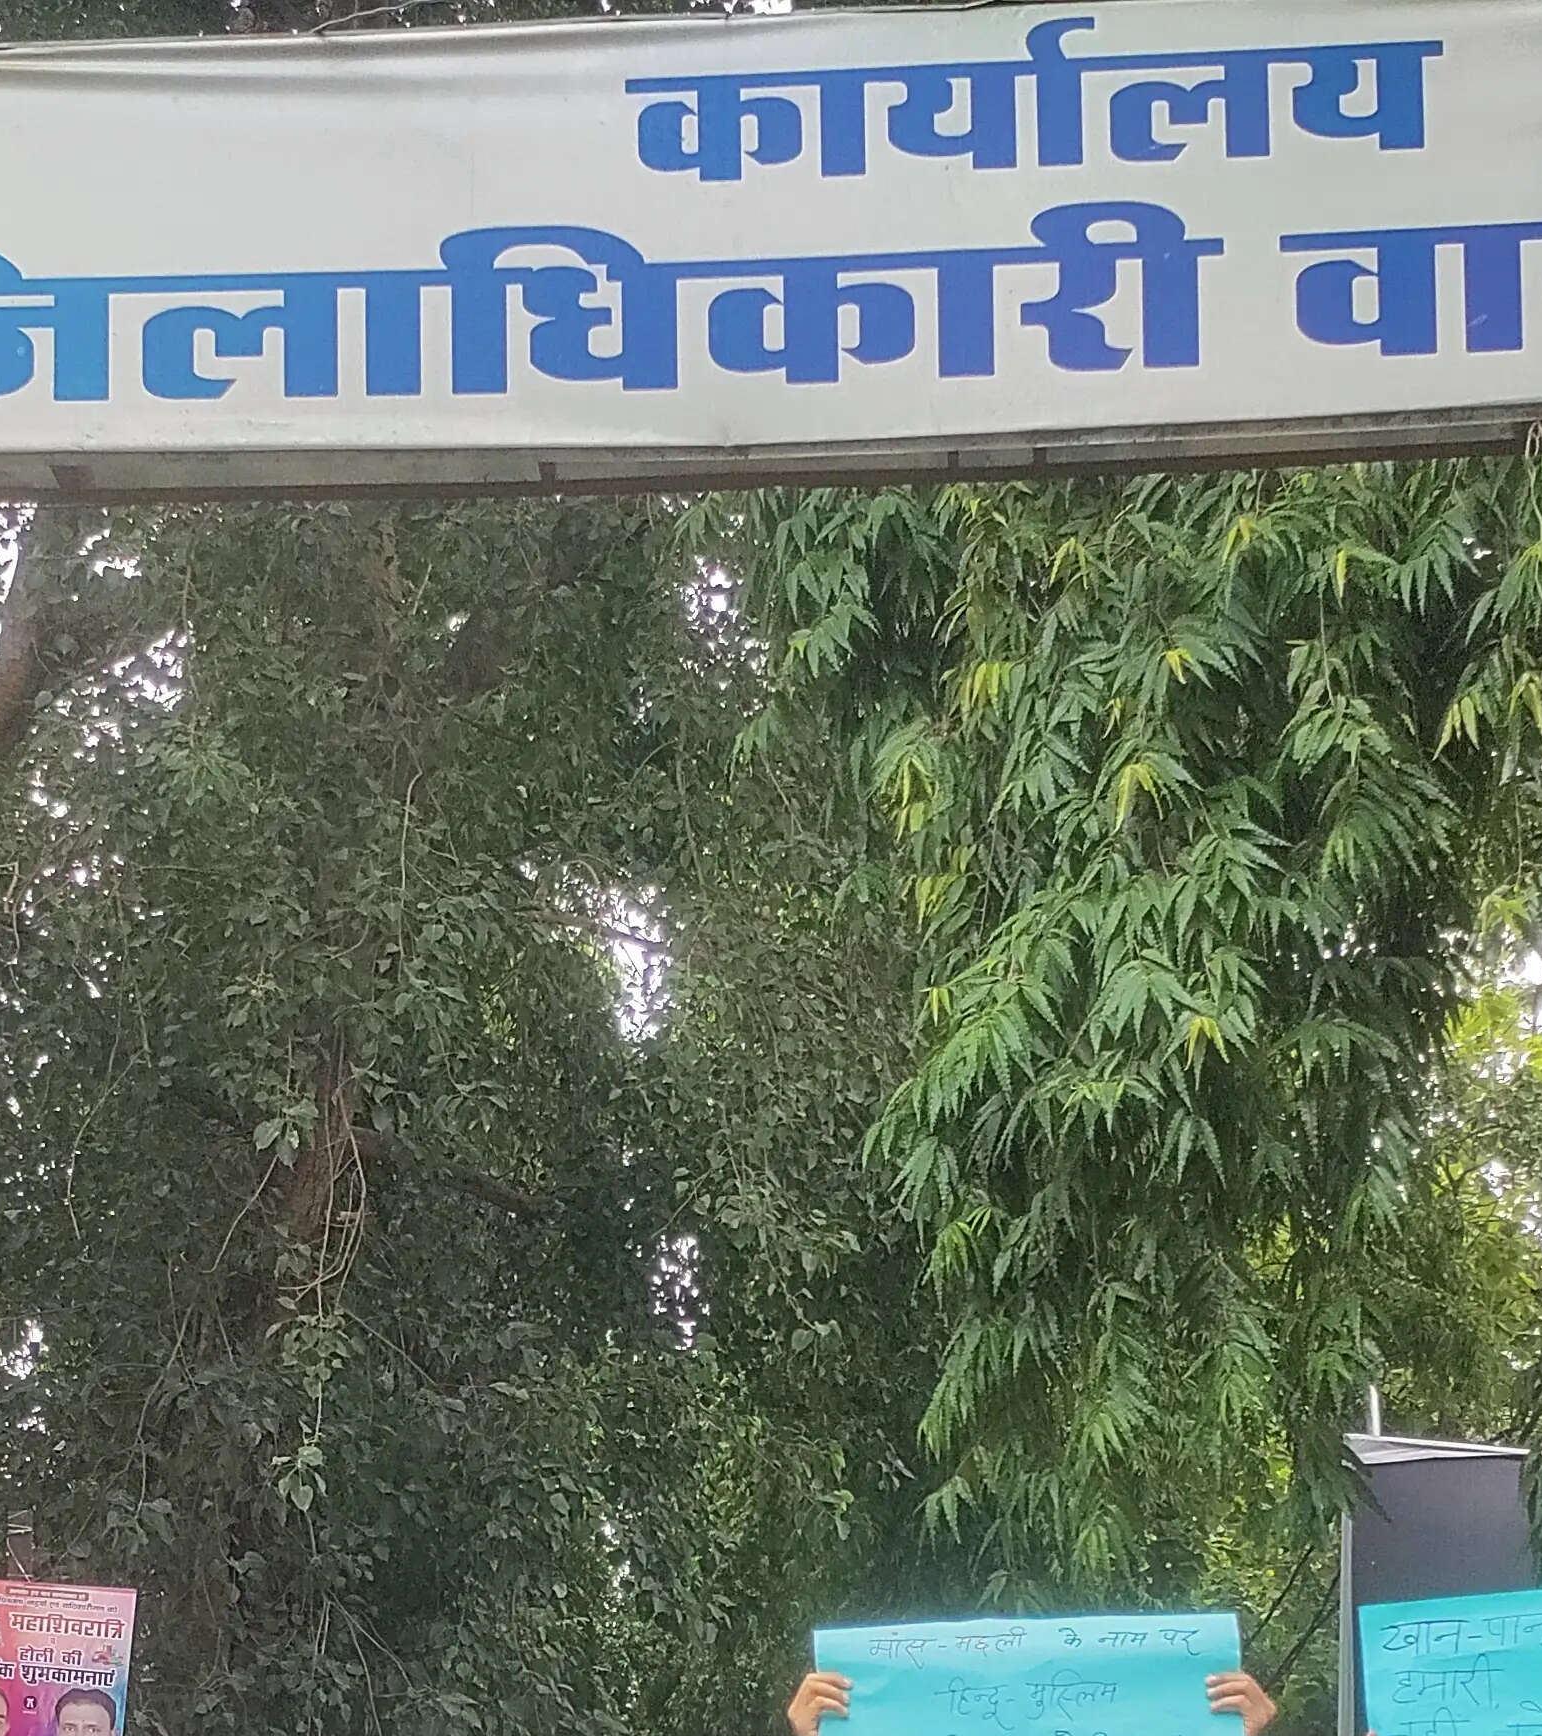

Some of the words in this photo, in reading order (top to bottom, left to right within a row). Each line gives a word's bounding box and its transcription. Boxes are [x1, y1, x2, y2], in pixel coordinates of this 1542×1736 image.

[624, 16, 1443, 182] कार्यालय
[10, 1613, 125, 1640] महाशिवरात्रि
[1058, 1627, 1082, 1648] के
[1098, 1631, 1148, 1648] नाम
[1158, 1629, 1202, 1656] पर
[19, 1645, 54, 1664] होली
[62, 1649, 83, 1666] की
[21, 1664, 116, 1686] शुभकामनाएं
